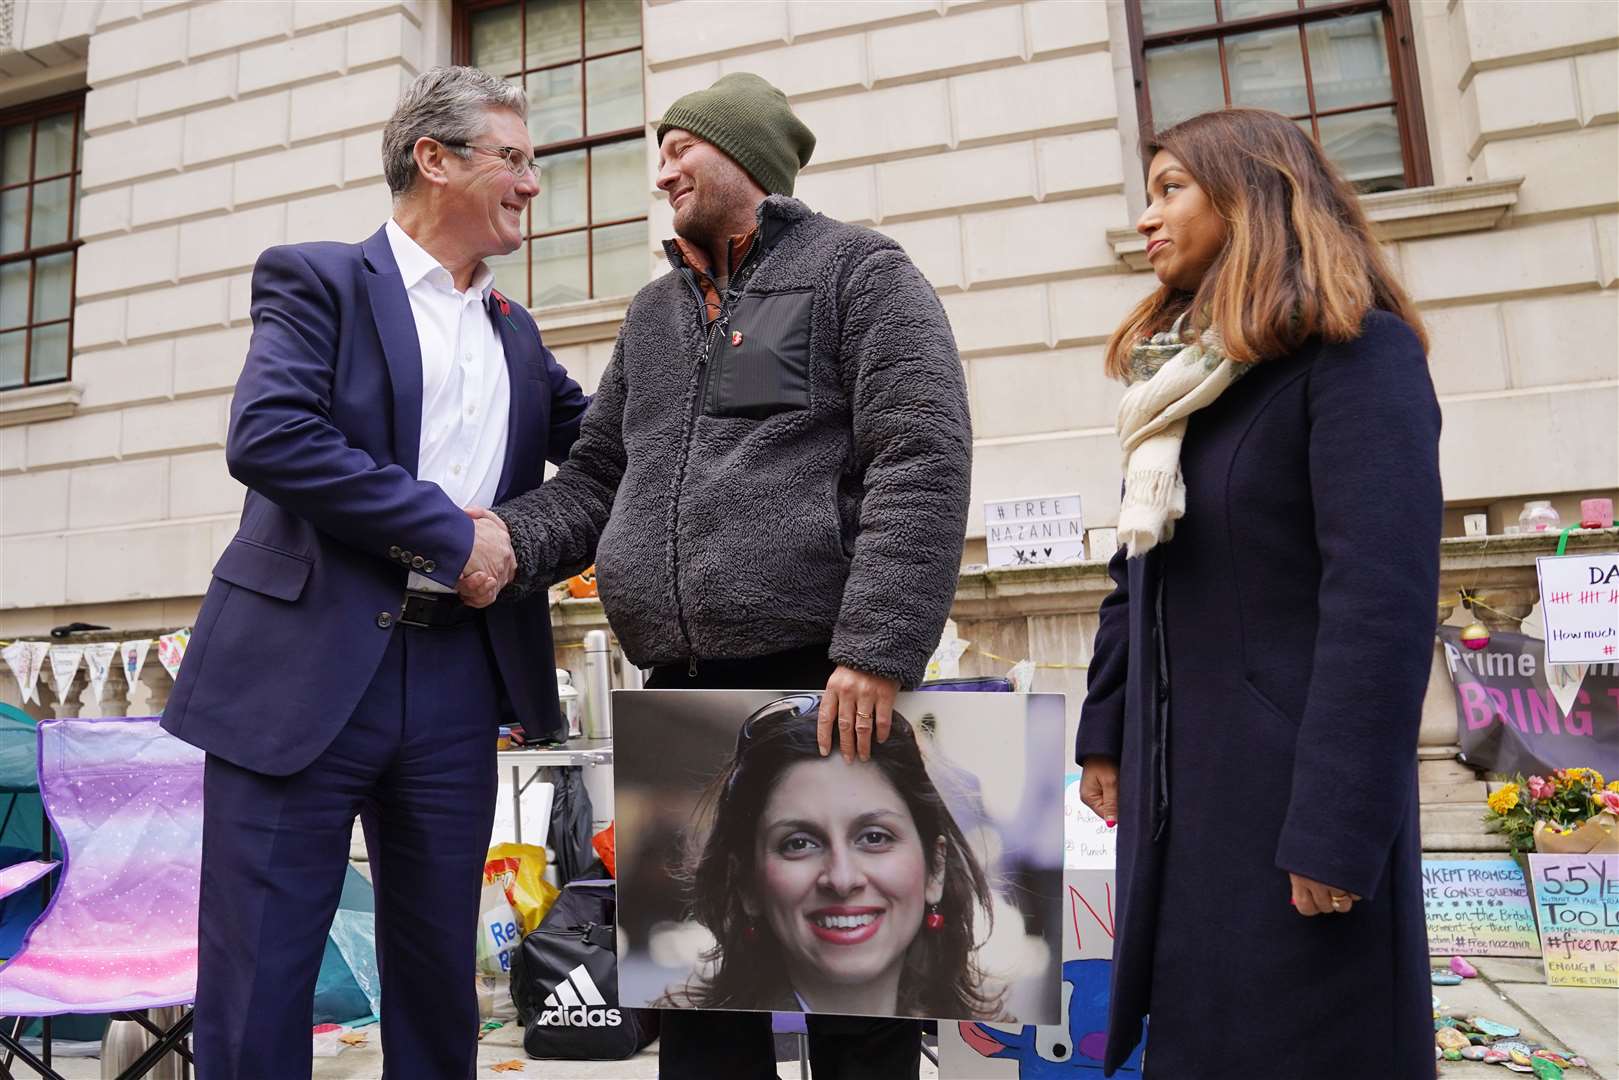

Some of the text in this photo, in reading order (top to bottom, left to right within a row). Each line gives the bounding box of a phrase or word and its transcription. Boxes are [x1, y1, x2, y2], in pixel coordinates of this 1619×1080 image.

[991, 521, 1078, 541] NAZANIN
[1553, 627, 1616, 641] How much
[1444, 642, 1536, 678] Prime
[1457, 681, 1593, 736] BRING
[536, 1004, 623, 1028] adidas
